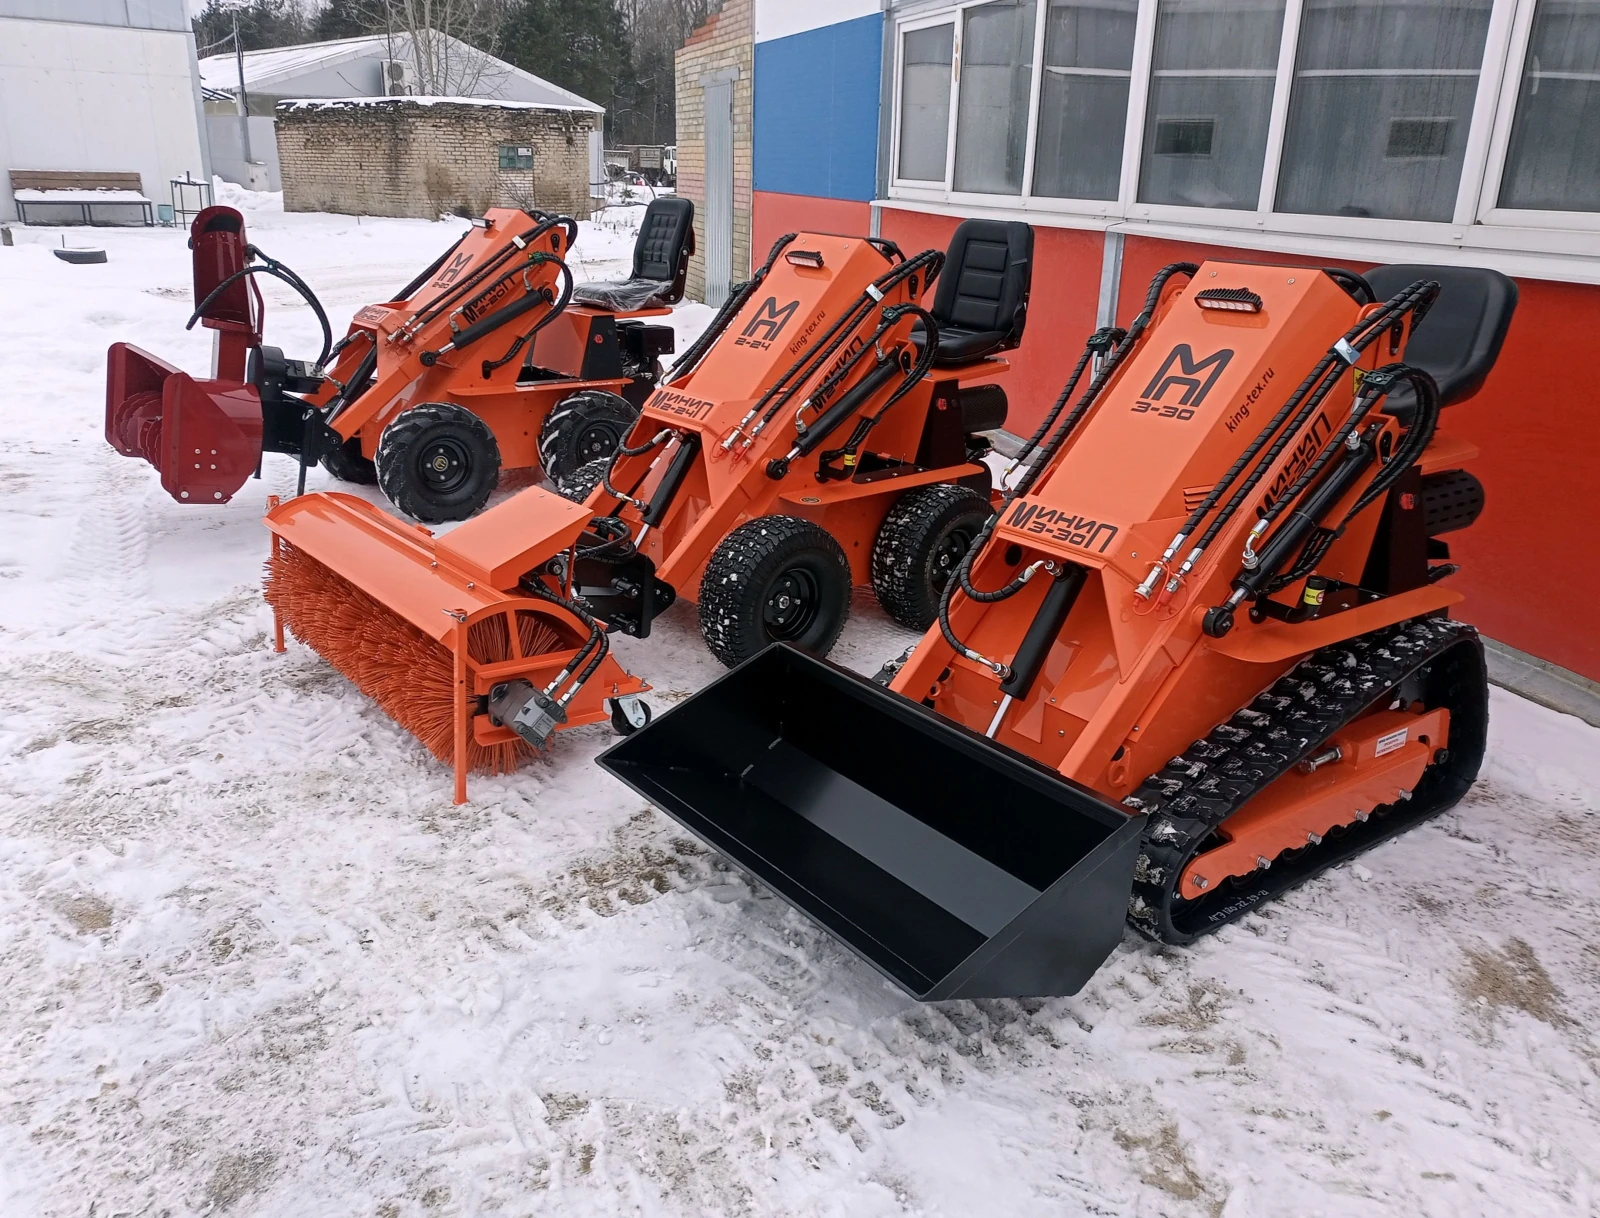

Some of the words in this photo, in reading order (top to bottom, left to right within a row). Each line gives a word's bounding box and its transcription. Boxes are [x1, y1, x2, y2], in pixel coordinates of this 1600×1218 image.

[477, 288, 506, 316] 2-20
[734, 337, 771, 351] 2-24
[789, 310, 827, 355] king-tex.ru
[648, 390, 714, 420] МИНИП
[660, 403, 695, 418] 2-24
[1130, 401, 1196, 421] 3-30
[1225, 367, 1276, 433] king-tex.ru
[1005, 501, 1119, 553] МИНИП
[1027, 520, 1087, 546] 3-30
